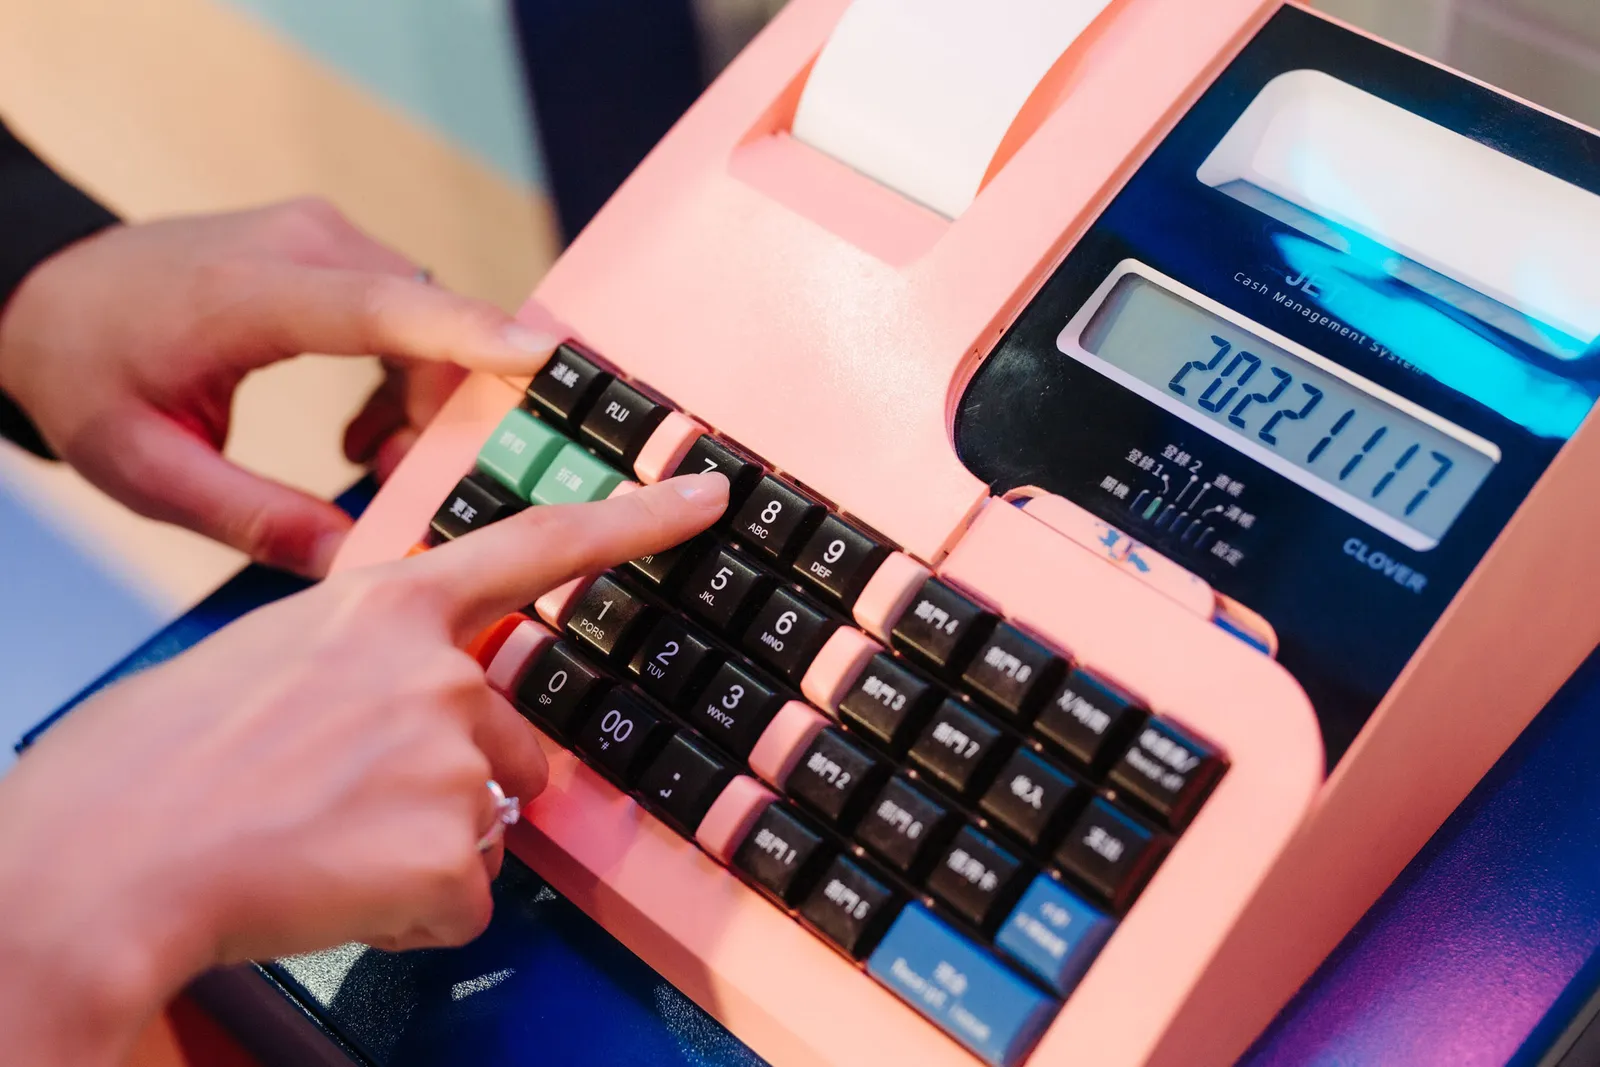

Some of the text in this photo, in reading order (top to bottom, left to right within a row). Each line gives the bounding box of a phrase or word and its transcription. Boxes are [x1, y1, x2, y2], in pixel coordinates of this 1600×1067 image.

[1234, 272, 1268, 295] Cash
[1272, 291, 1366, 345] Management
[605, 401, 630, 422] PLU
[1168, 334, 1453, 517] 20221117
[449, 497, 477, 523] 更正
[760, 501, 782, 524] 8
[748, 522, 769, 540] ABC
[823, 540, 846, 564] 9
[810, 563, 832, 579] DEF
[1342, 537, 1428, 593] CLOVER
[711, 567, 733, 590] 5
[598, 599, 614, 620] 1
[699, 591, 715, 606] JKL
[580, 618, 605, 641] PQRS
[775, 611, 797, 634] 6
[656, 641, 679, 665] 2
[760, 632, 784, 652] MNO
[548, 670, 568, 692] 0
[646, 661, 666, 679] TUV
[538, 694, 552, 706] SP
[722, 684, 744, 709] 3
[600, 710, 634, 742] 00
[707, 704, 735, 729] WXYZ
